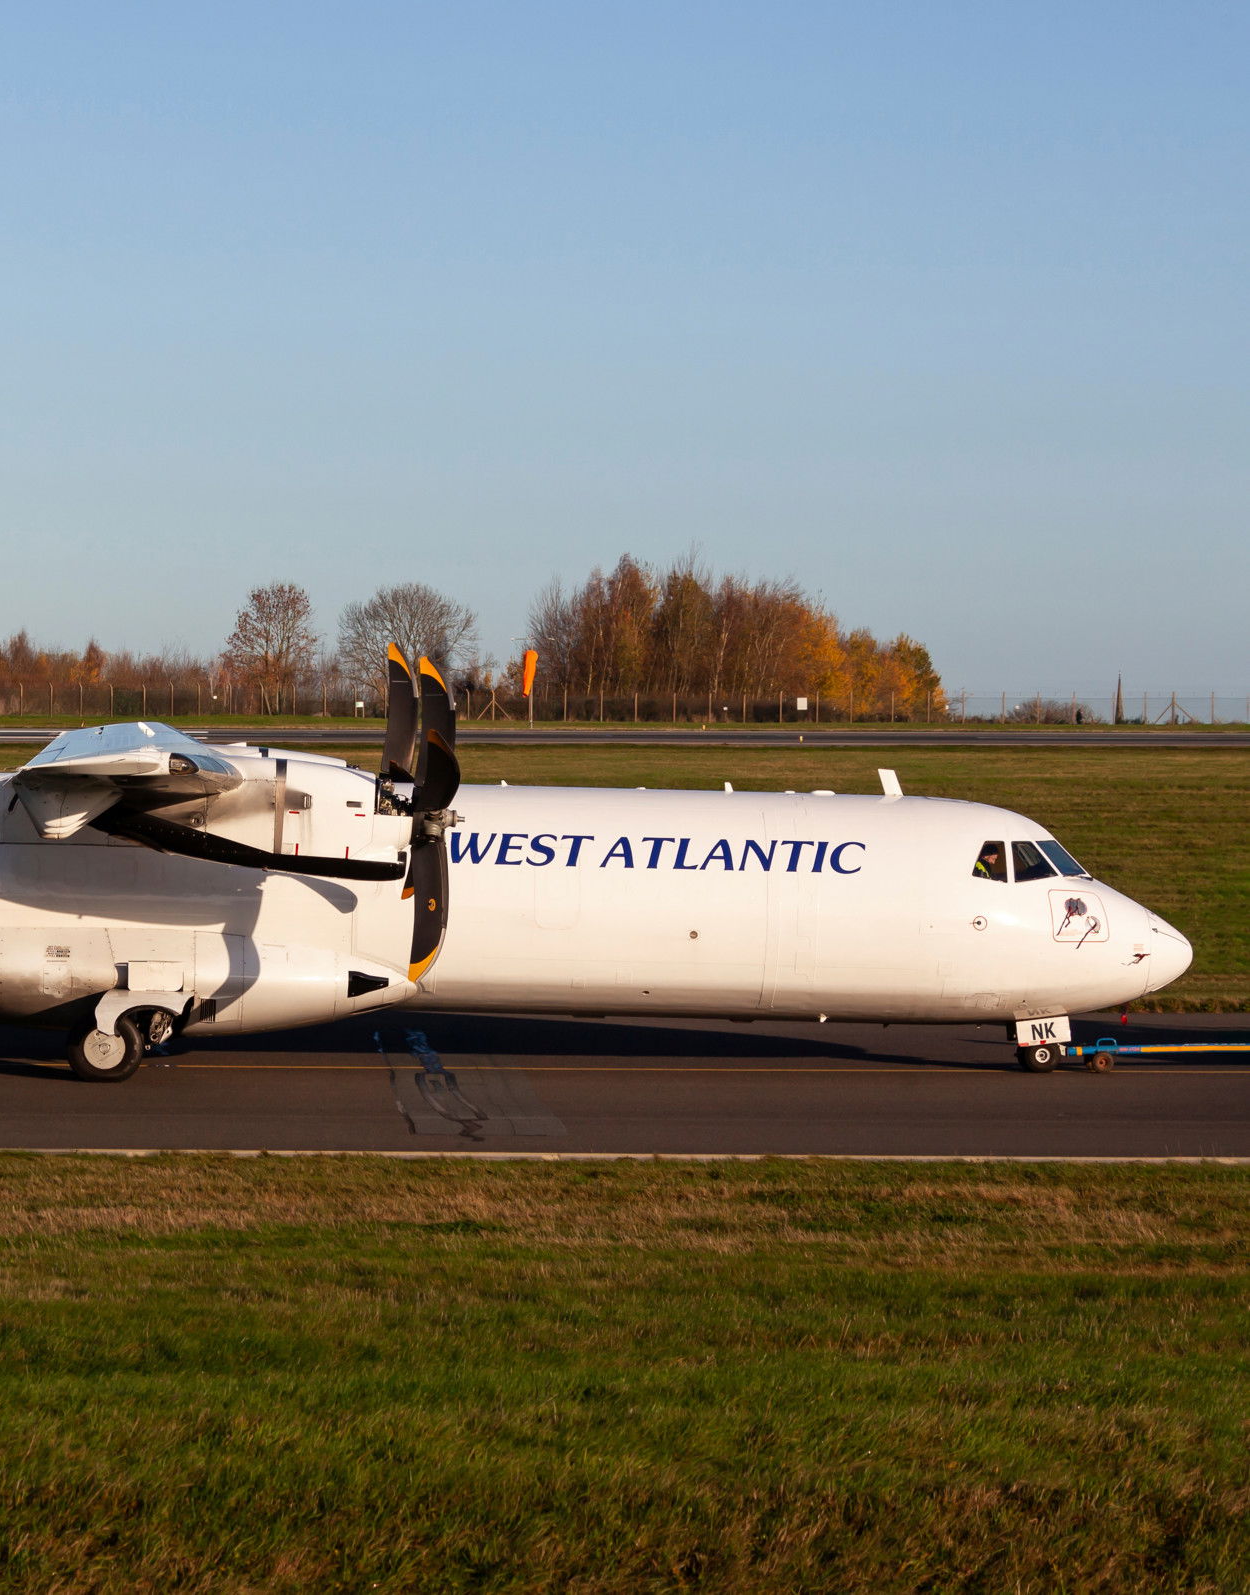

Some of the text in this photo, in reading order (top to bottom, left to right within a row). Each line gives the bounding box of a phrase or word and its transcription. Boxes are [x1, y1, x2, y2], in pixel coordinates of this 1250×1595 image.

[450, 832, 866, 874] WEST ATLANTIC
[1031, 1022, 1056, 1040] NK
